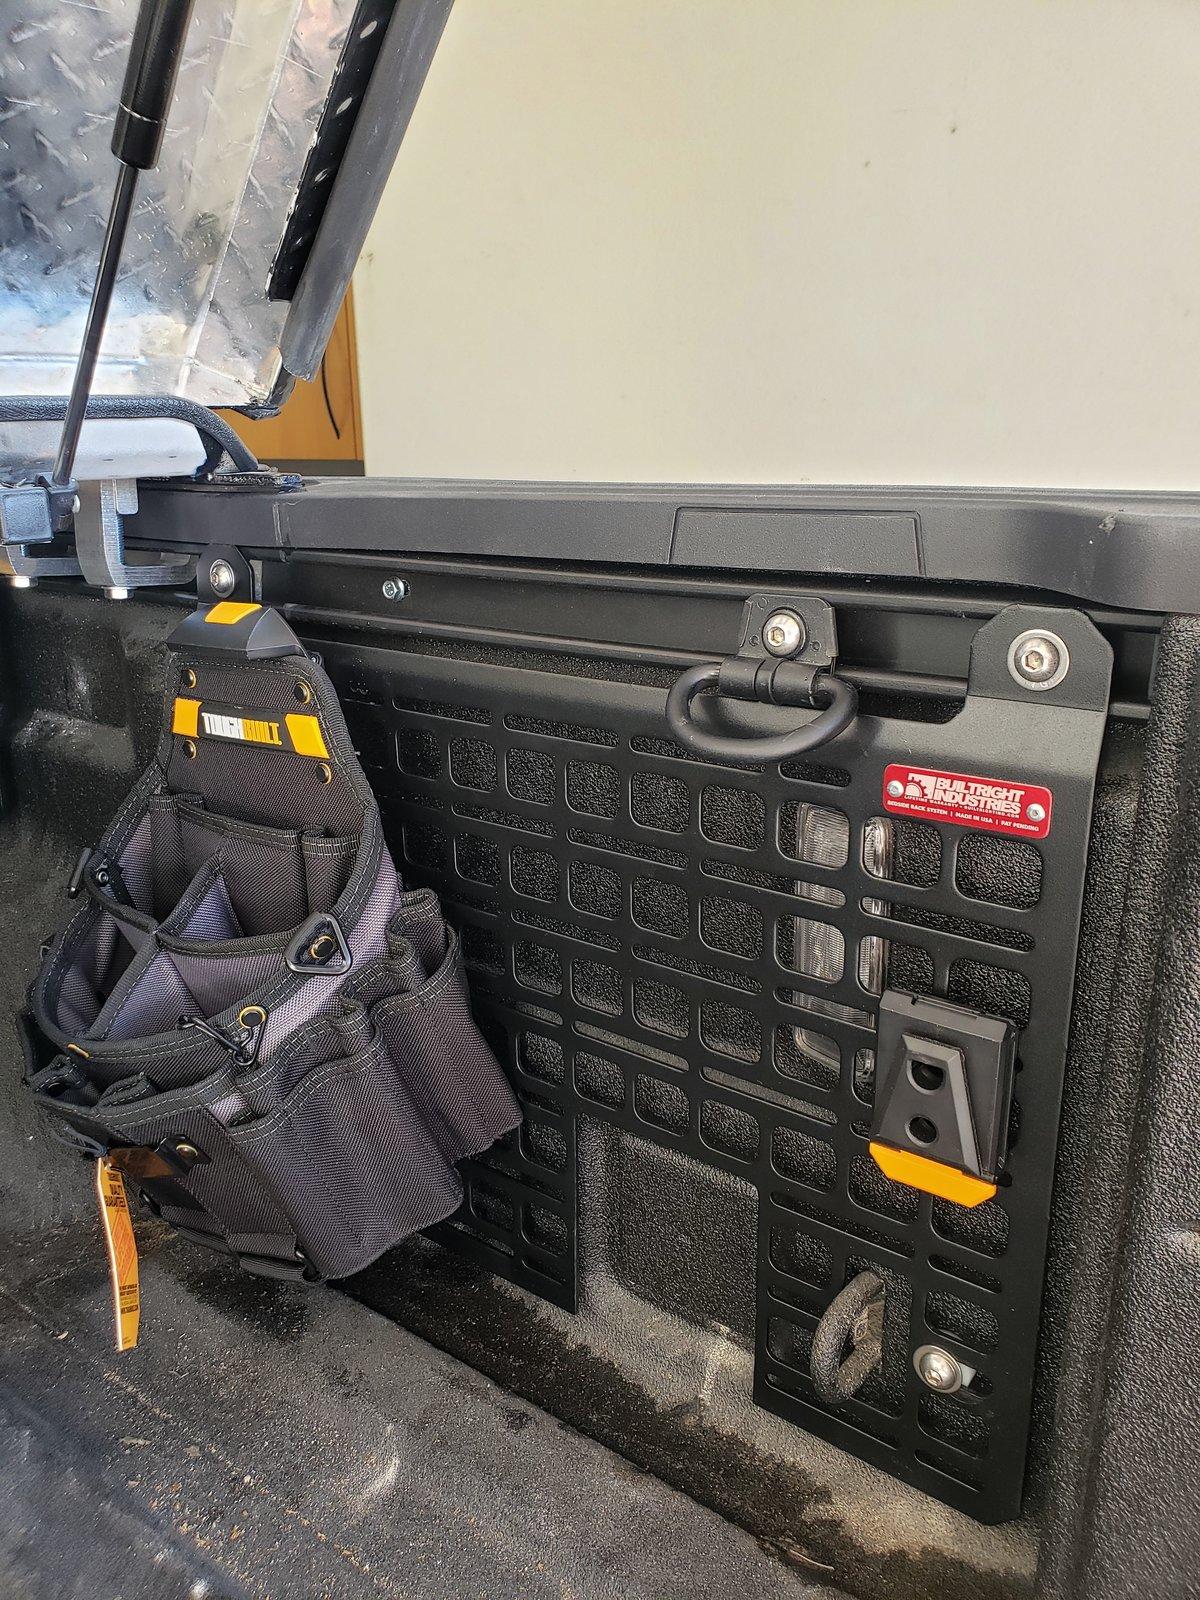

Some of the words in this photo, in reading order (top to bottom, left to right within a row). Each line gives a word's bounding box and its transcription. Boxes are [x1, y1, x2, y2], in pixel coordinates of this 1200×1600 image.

[933, 789, 1021, 815] INDUSTRIES
[935, 777, 1025, 802] BUILTRIGHT
[926, 807, 948, 815] SYSTEM
[955, 812, 972, 820] MADE
[981, 816, 993, 824] USA
[1001, 820, 1012, 828] PAT
[1013, 822, 1039, 831] PENDING
